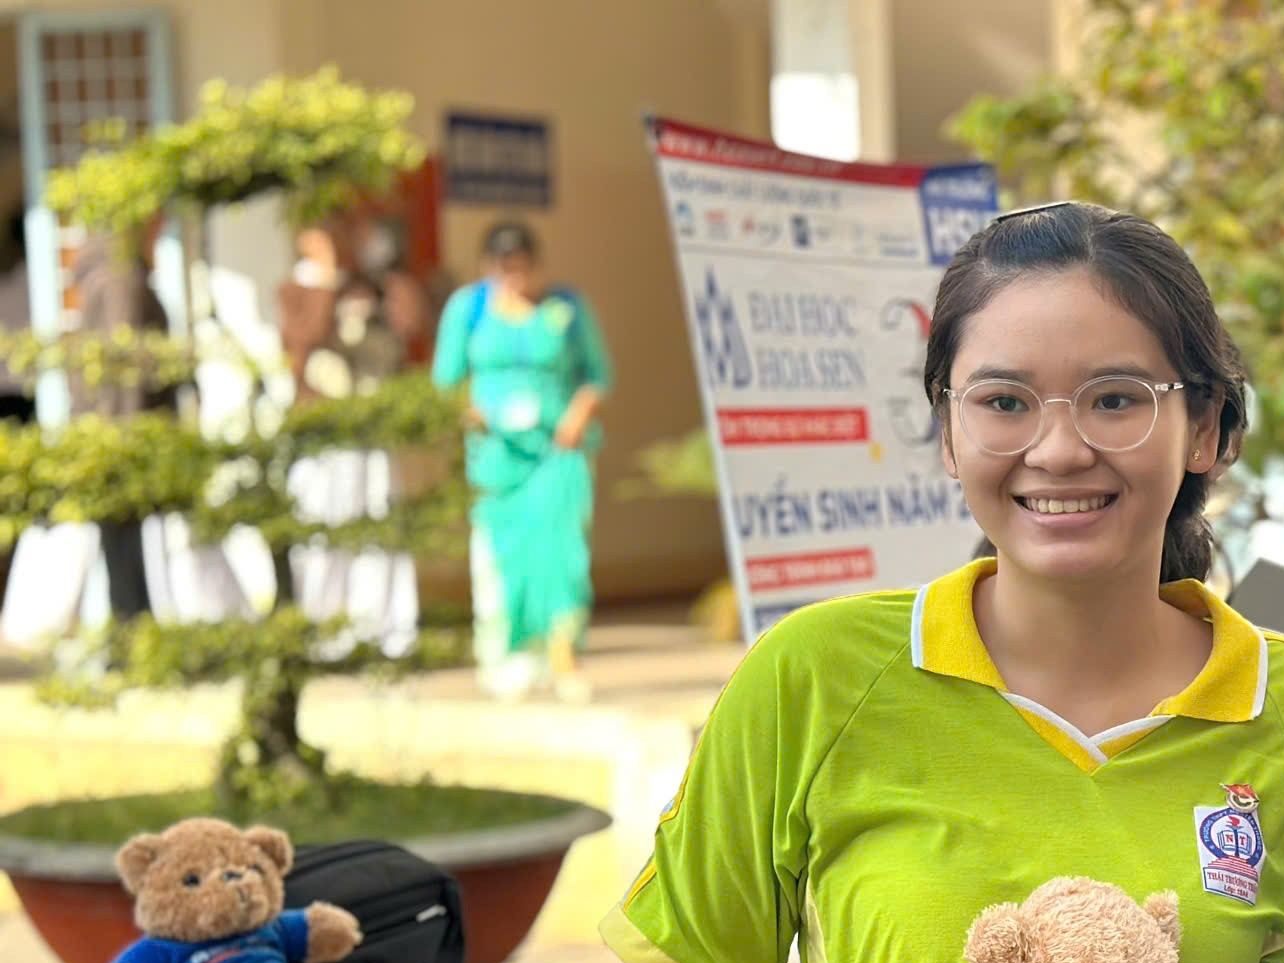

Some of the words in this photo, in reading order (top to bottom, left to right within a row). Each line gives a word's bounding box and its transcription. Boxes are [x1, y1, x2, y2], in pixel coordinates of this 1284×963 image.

[817, 487, 884, 533] SINH
[1225, 833, 1234, 844] N
[1239, 836, 1247, 846] T
